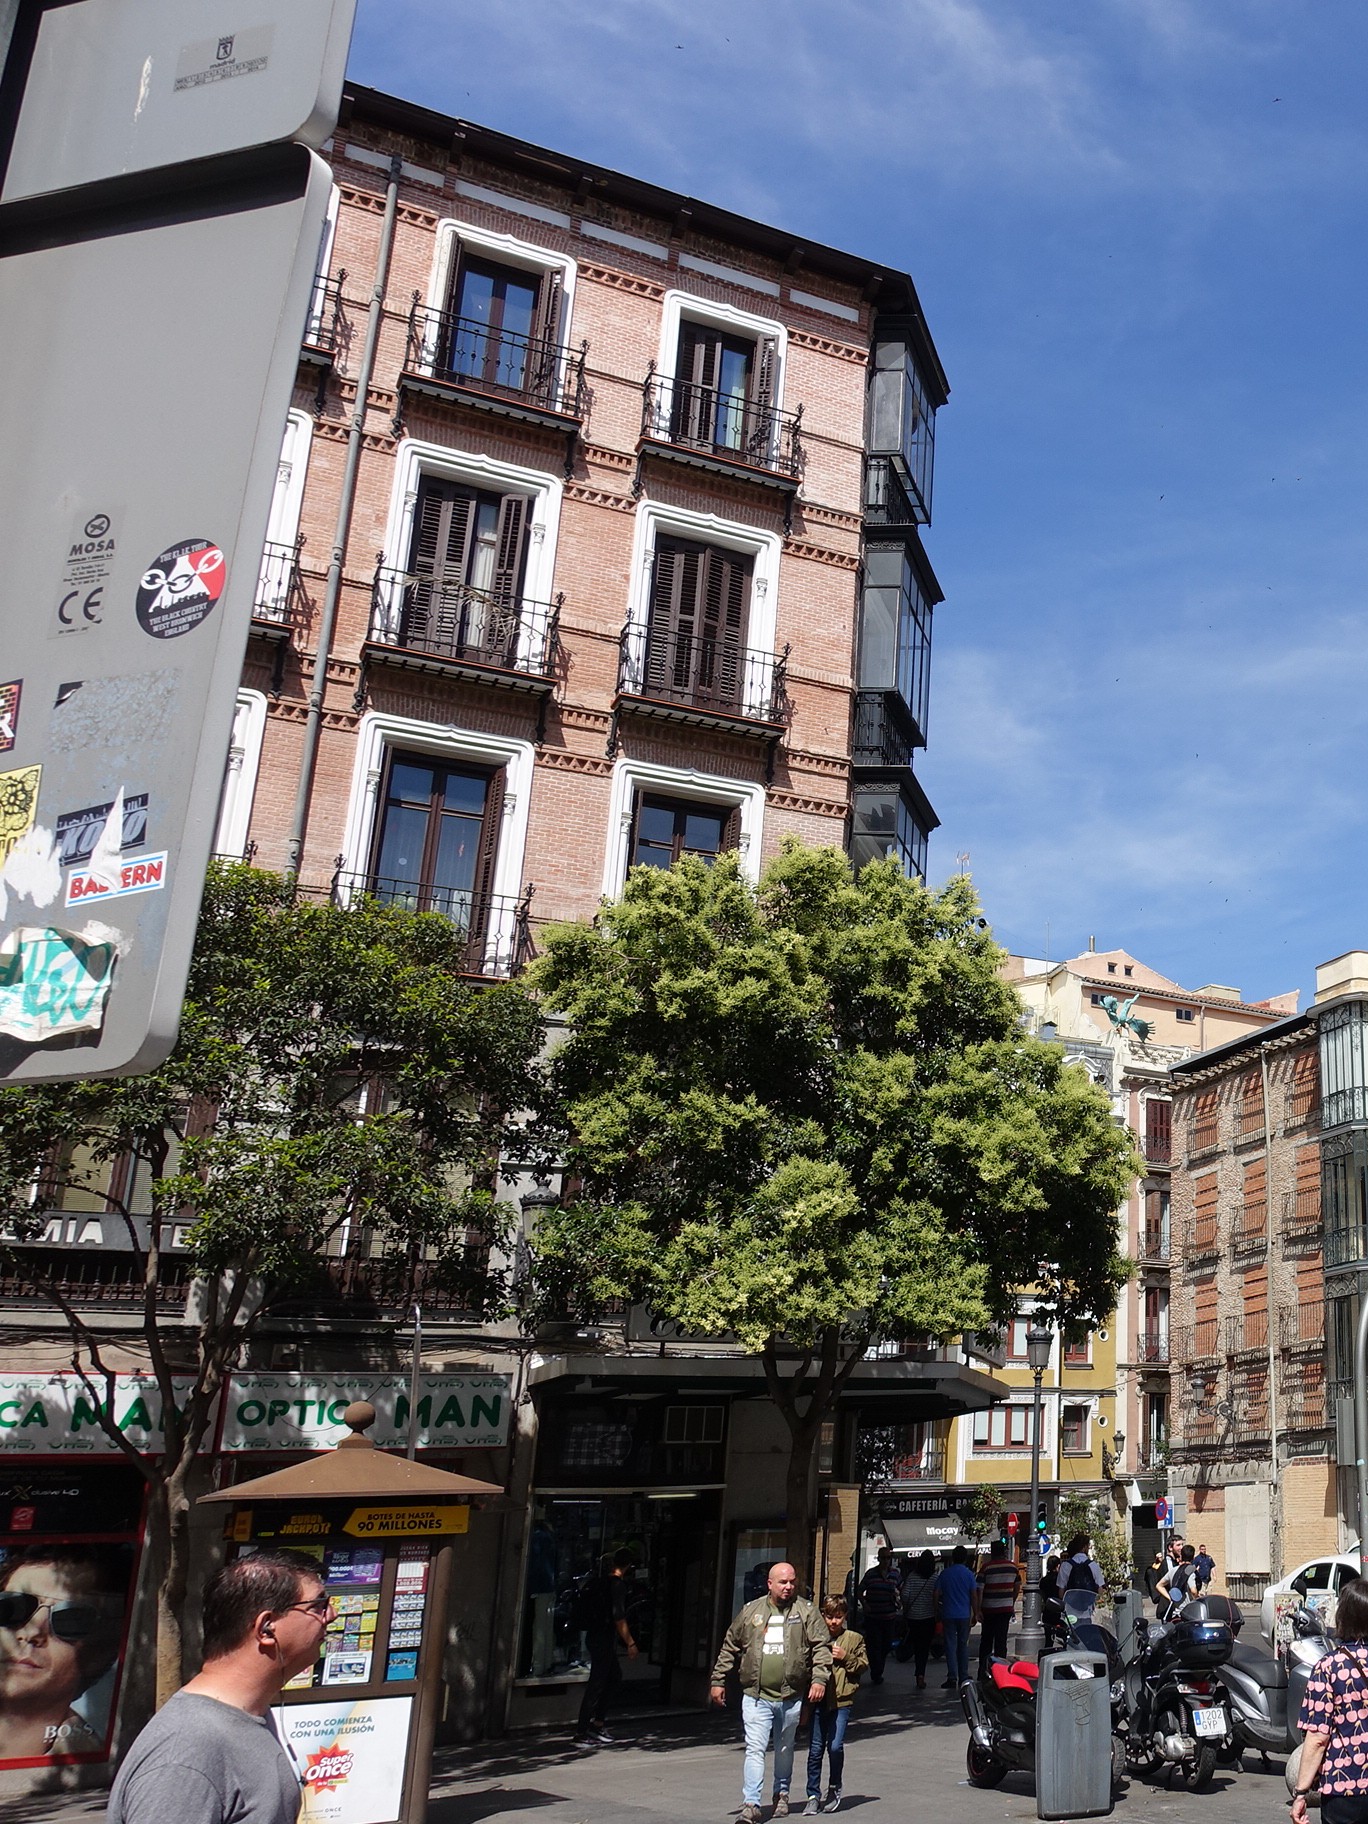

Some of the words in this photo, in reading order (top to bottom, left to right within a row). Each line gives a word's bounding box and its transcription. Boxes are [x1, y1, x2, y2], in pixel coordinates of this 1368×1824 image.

[209, 57, 236, 69] madrid
[69, 539, 115, 556] MOSA
[161, 609, 181, 622] BLACK
[60, 809, 148, 858] KOO
[69, 860, 164, 900] BAERN
[394, 1394, 502, 1429] MAN
[899, 1498, 948, 1512] CAFETERÍA
[367, 1513, 393, 1521] BOTES
[408, 1512, 436, 1520] HASTA
[357, 1521, 375, 1532] 90
[378, 1519, 442, 1531] MILLONES
[926, 1527, 959, 1536] Mocay
[294, 1719, 321, 1729] TODO
[323, 1715, 373, 1726] COMIENZA
[1201, 1709, 1223, 1721] 1202
[289, 1730, 312, 1739] CON
[313, 1728, 335, 1737] UNA
[337, 1724, 375, 1735] ILUSIÓN
[1202, 1720, 1218, 1730] GYP
[319, 1752, 354, 1768] Super
